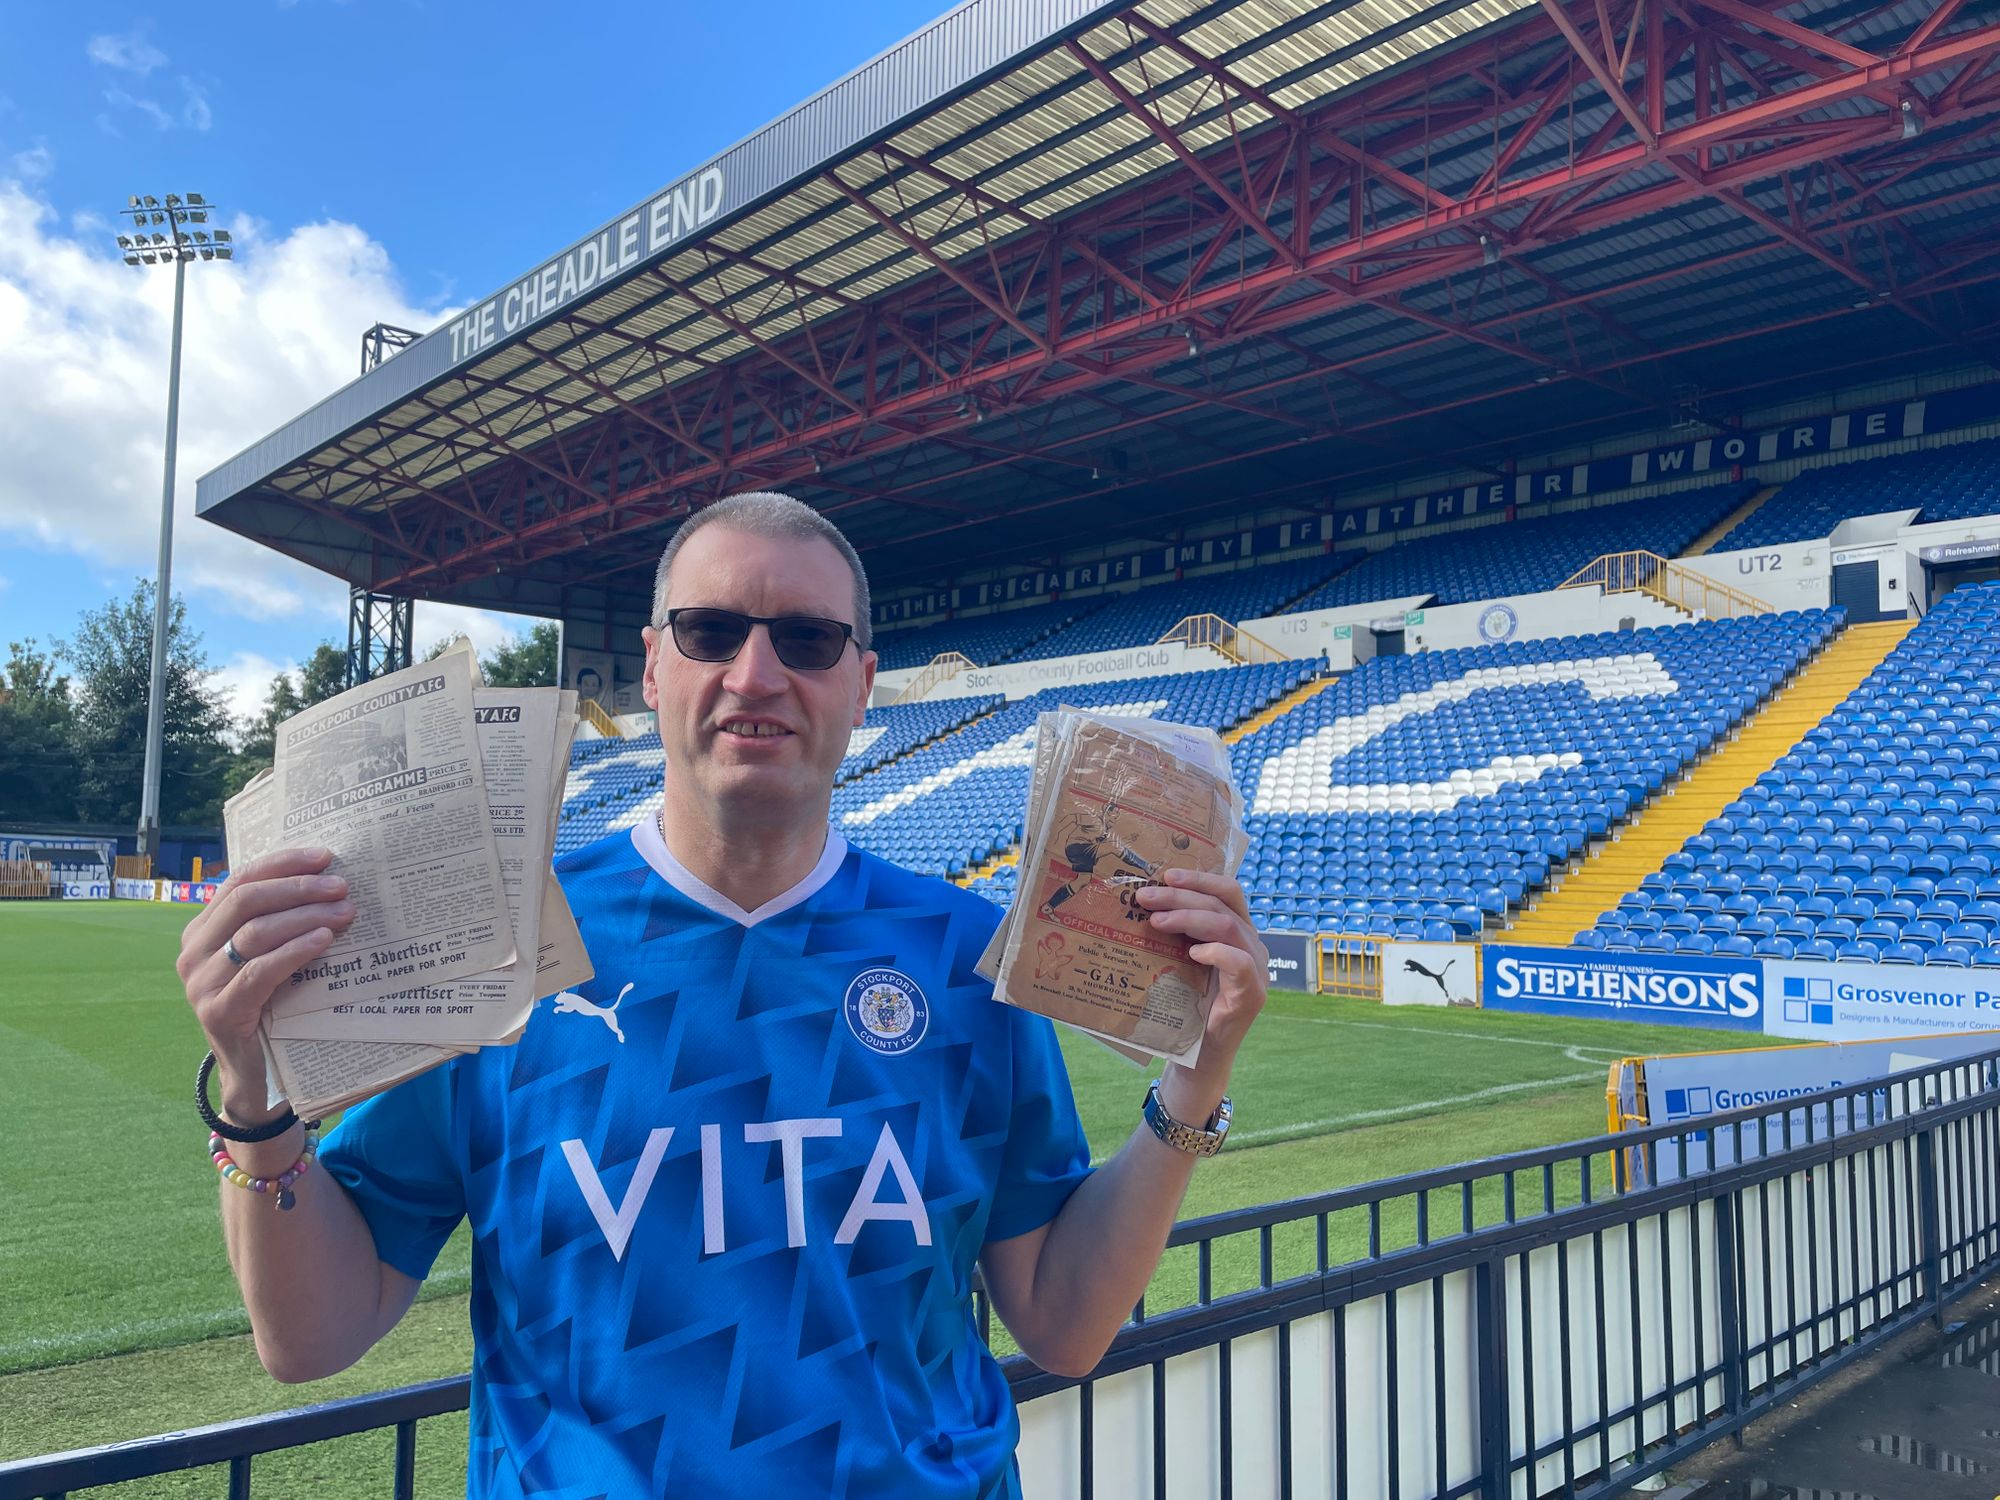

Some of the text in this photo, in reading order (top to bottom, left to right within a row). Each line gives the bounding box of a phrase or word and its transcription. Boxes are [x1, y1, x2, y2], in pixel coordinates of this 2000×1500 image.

[450, 167, 723, 362] THE CHEADLE END
[890, 412, 1887, 617] THE SCARF MY FATHER WORE
[1739, 553, 1782, 575] UT2
[1281, 618, 1308, 635] UT3
[1029, 663, 1075, 684] County
[1077, 653, 1133, 675] Football
[1135, 648, 1169, 668] Club
[287, 706, 359, 746] STOCKPORT
[363, 686, 414, 714] COUNTY
[429, 764, 456, 777] PRICE
[286, 769, 426, 827] OFFICIAL PROGRAMME
[418, 780, 456, 797] BRADFORD
[379, 809, 399, 821] and
[405, 802, 435, 815] Views
[468, 924, 493, 935] FRIDAY
[1063, 916, 1180, 957] OFFICIAL PROGRAMME
[290, 940, 443, 987] Stockport Advertiser
[1078, 945, 1099, 957] Public
[1103, 952, 1128, 965] Servant
[1131, 960, 1143, 969] No.
[328, 951, 467, 991] BEST LOCAL PAPER FOR SPORT
[1582, 963, 1655, 975] A FAMILY BUSINESS
[857, 973, 915, 994] STOCKPORT
[1083, 980, 1131, 998] SHOWROOMS
[1495, 957, 1760, 1018] STEPHENSONS
[1837, 983, 1967, 1008] Grosvenor
[333, 1005, 474, 1015] BEST LOCAL PAPER FOR SPORT
[1839, 1011, 1881, 1024] Designers
[1883, 1013, 1890, 1024] &
[1892, 1015, 1956, 1028] Manufacturers
[1957, 1020, 1967, 1029] of
[860, 1030, 914, 1049] COUNTY FC
[559, 1117, 933, 1264] VITA
